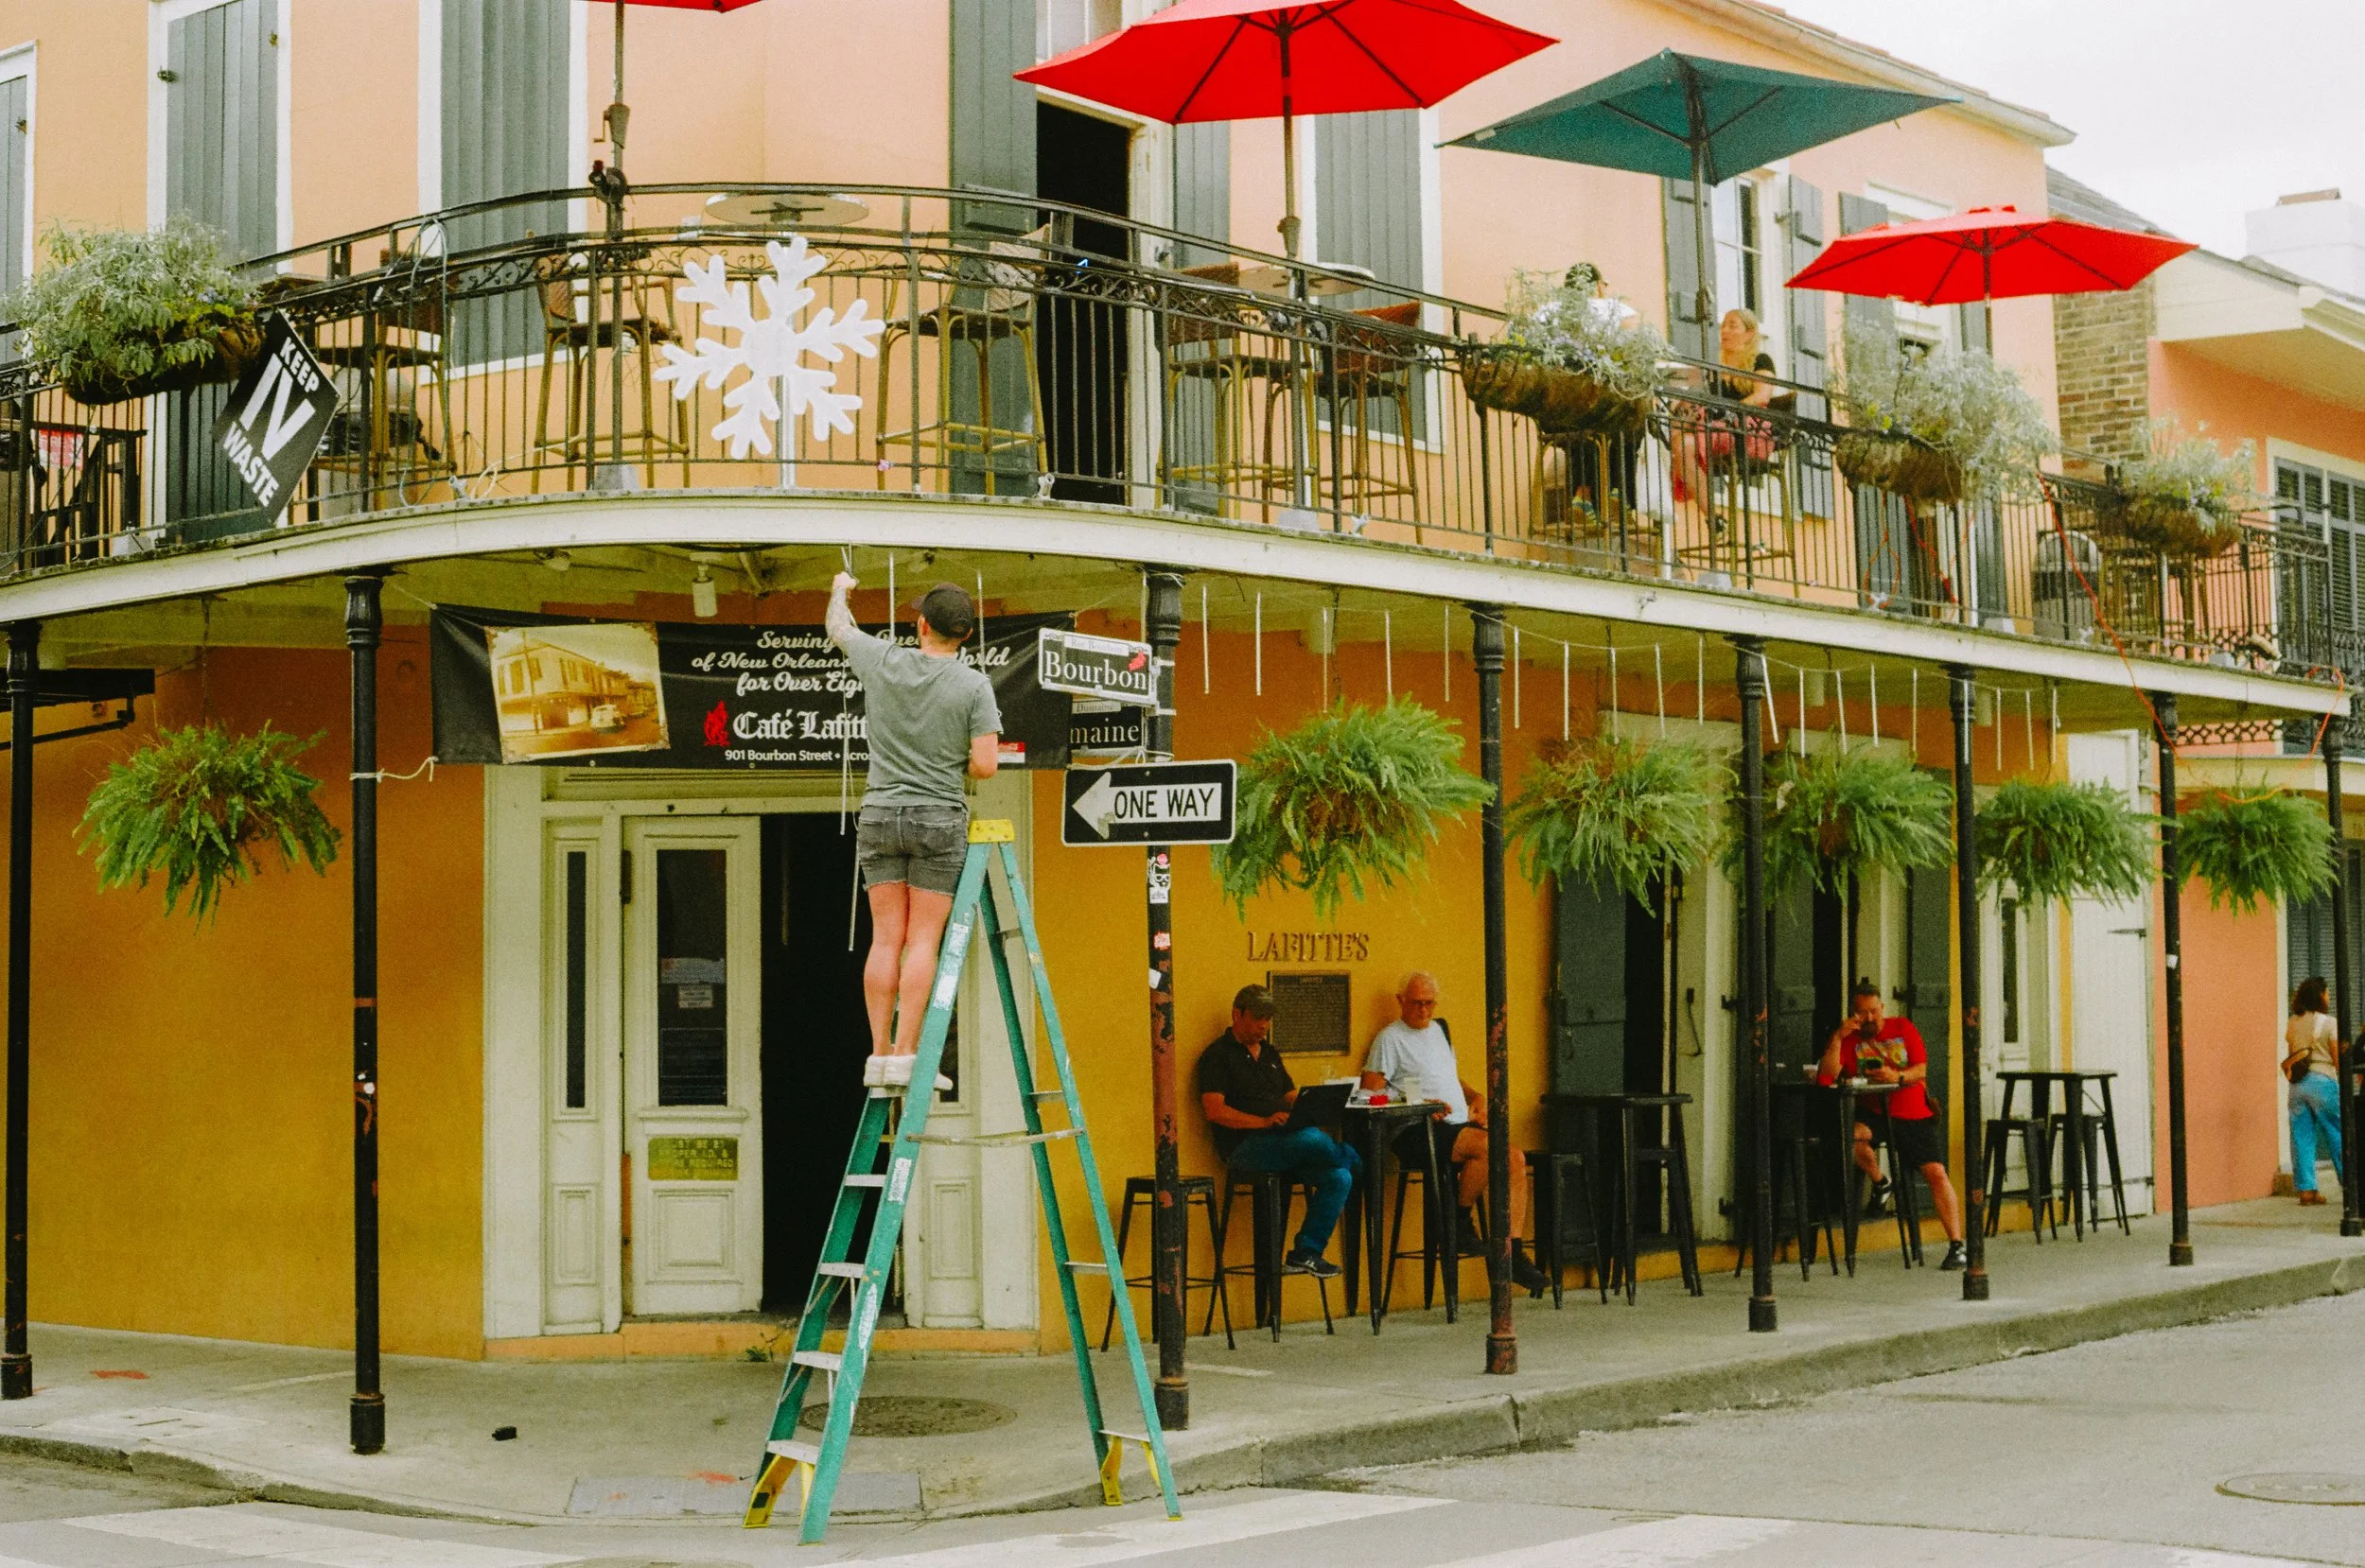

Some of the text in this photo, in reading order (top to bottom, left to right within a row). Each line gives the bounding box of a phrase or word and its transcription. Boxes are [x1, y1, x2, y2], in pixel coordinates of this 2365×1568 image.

[280, 336, 320, 392] KEEP
[223, 421, 280, 508] WASTE
[757, 629, 920, 653] Serving Que
[692, 652, 716, 671] of
[717, 652, 769, 669] New
[772, 652, 851, 669] Orleans
[1044, 651, 1147, 690] Bourbon
[736, 671, 771, 697] for
[773, 671, 822, 692] Over
[732, 708, 867, 740] Café Lafitt
[1070, 717, 1140, 744] maine
[725, 749, 745, 760] 901
[747, 749, 797, 761] Bourbon
[799, 749, 833, 761] Street
[1114, 788, 1215, 820] ONE WAY
